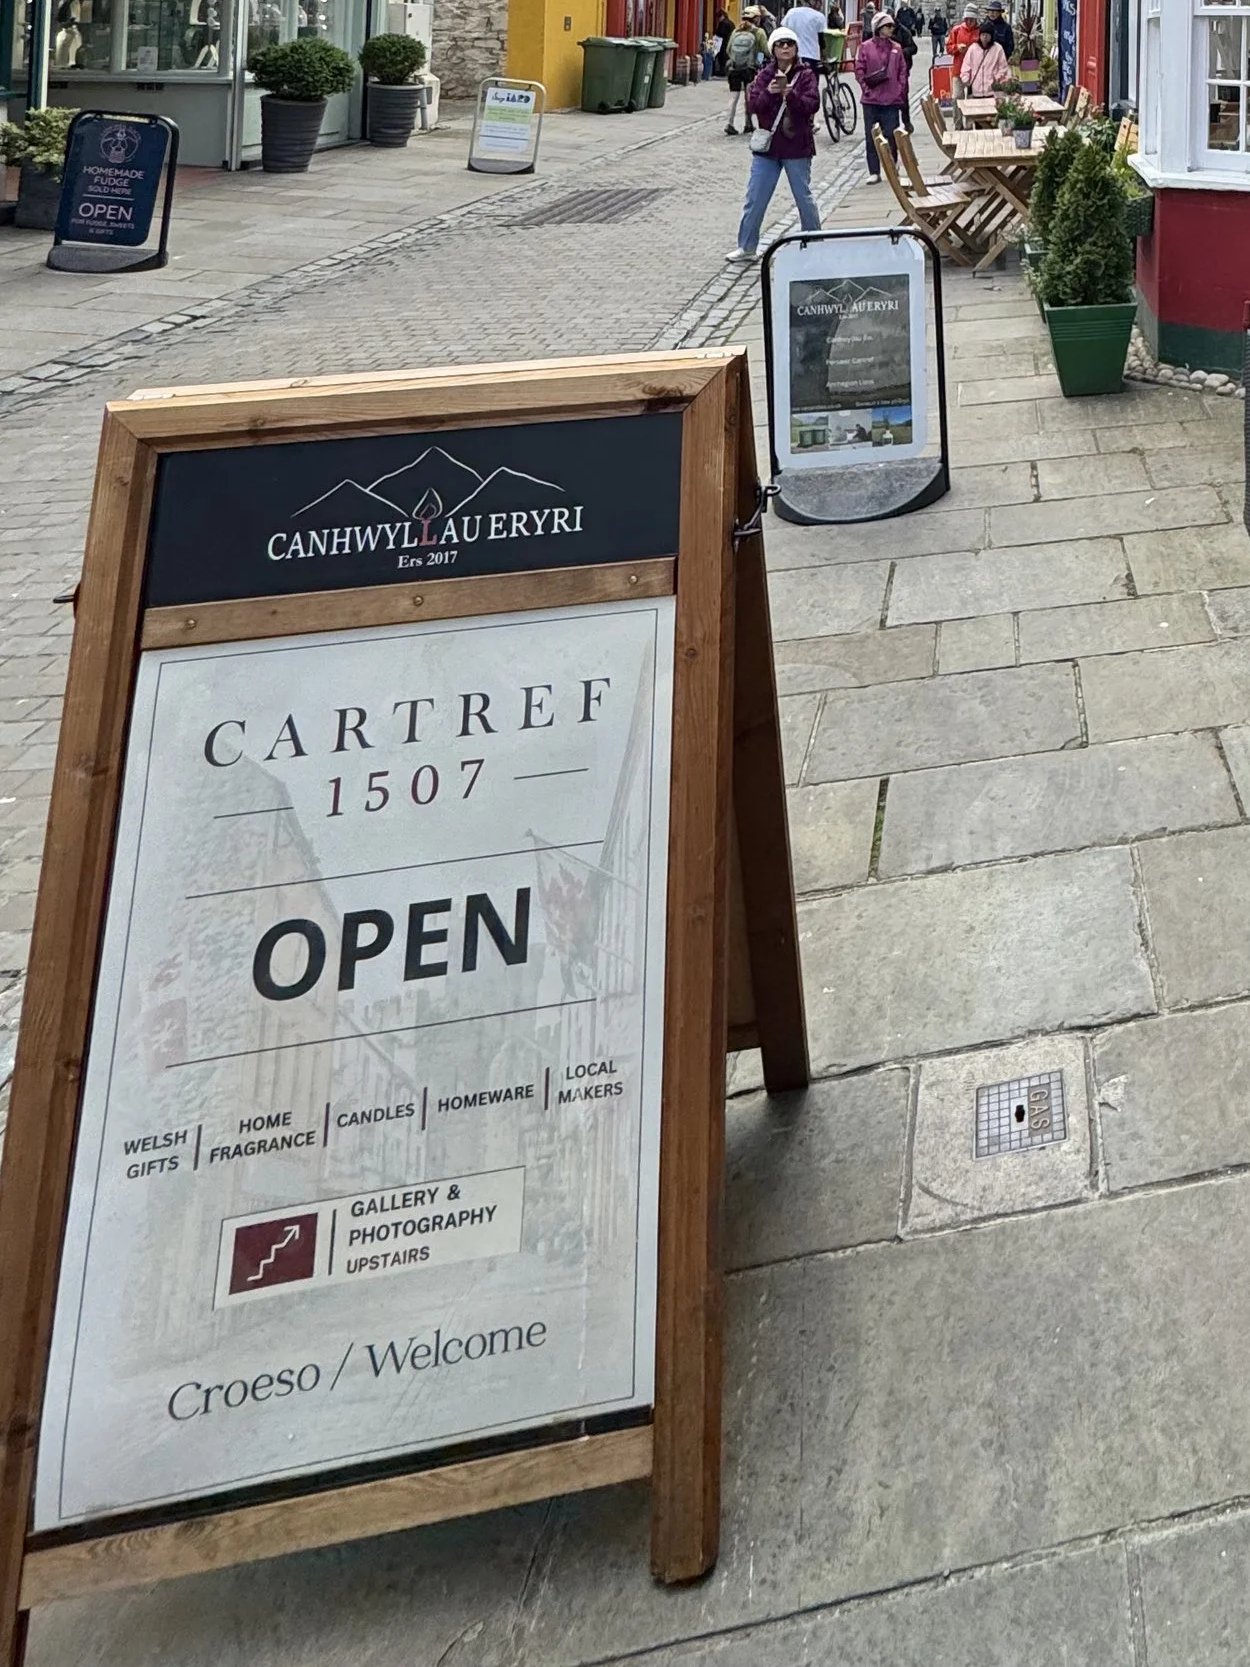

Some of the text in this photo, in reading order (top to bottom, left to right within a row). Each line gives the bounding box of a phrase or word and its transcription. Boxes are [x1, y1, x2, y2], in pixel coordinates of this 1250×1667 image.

[82, 166, 145, 180] HOMEMADE
[94, 175, 130, 187] FUDGE
[88, 185, 132, 195] SOLD HERE
[79, 202, 133, 221] OPEN
[487, 505, 585, 540] ERYRI
[397, 550, 459, 569] Ers 2017
[202, 677, 613, 769] CARTREF
[325, 758, 488, 819] 1507
[252, 886, 532, 1002] OPEN
[565, 1060, 618, 1081] LOCAL
[437, 1084, 535, 1114] HOMEWARE
[557, 1082, 624, 1106] MAKERS
[336, 1103, 415, 1129] CANDLES
[1030, 1088, 1051, 1131] GAS
[238, 1112, 293, 1135] HOME
[123, 1130, 188, 1156] WELSH
[209, 1131, 316, 1165] FRAGRANCE
[126, 1155, 180, 1180] GIFTS
[350, 1184, 462, 1219] GALLERY &
[349, 1204, 498, 1247] PHOTOGRAPHY
[346, 1246, 430, 1275] UPSTAIRS
[166, 1361, 322, 1422] Croeso
[365, 1316, 548, 1378] Welcome
